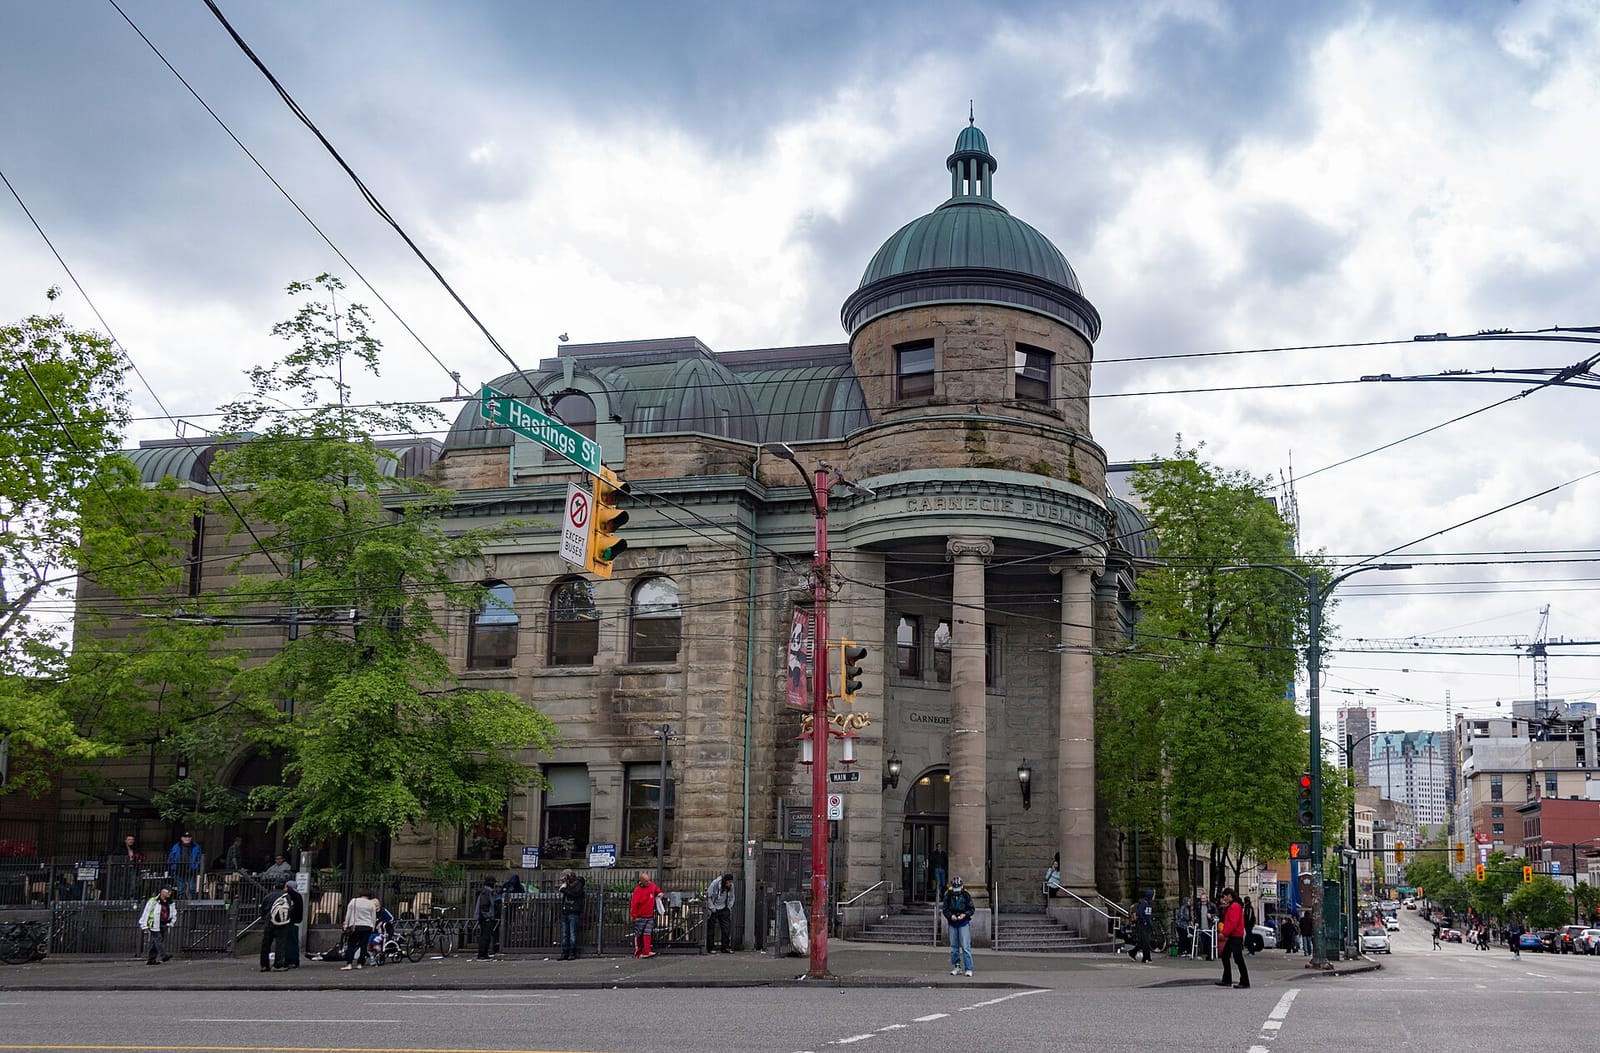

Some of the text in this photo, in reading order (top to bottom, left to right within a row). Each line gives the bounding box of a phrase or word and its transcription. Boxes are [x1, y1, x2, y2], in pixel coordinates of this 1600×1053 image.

[510, 401, 576, 454] Hastings
[581, 441, 596, 465] St
[906, 497, 1014, 512] CARNEGIE
[1022, 501, 1081, 528] PUBLIC
[565, 529, 585, 546] EXCEPT
[564, 541, 582, 557] BUSES
[833, 773, 847, 781] MAIN
